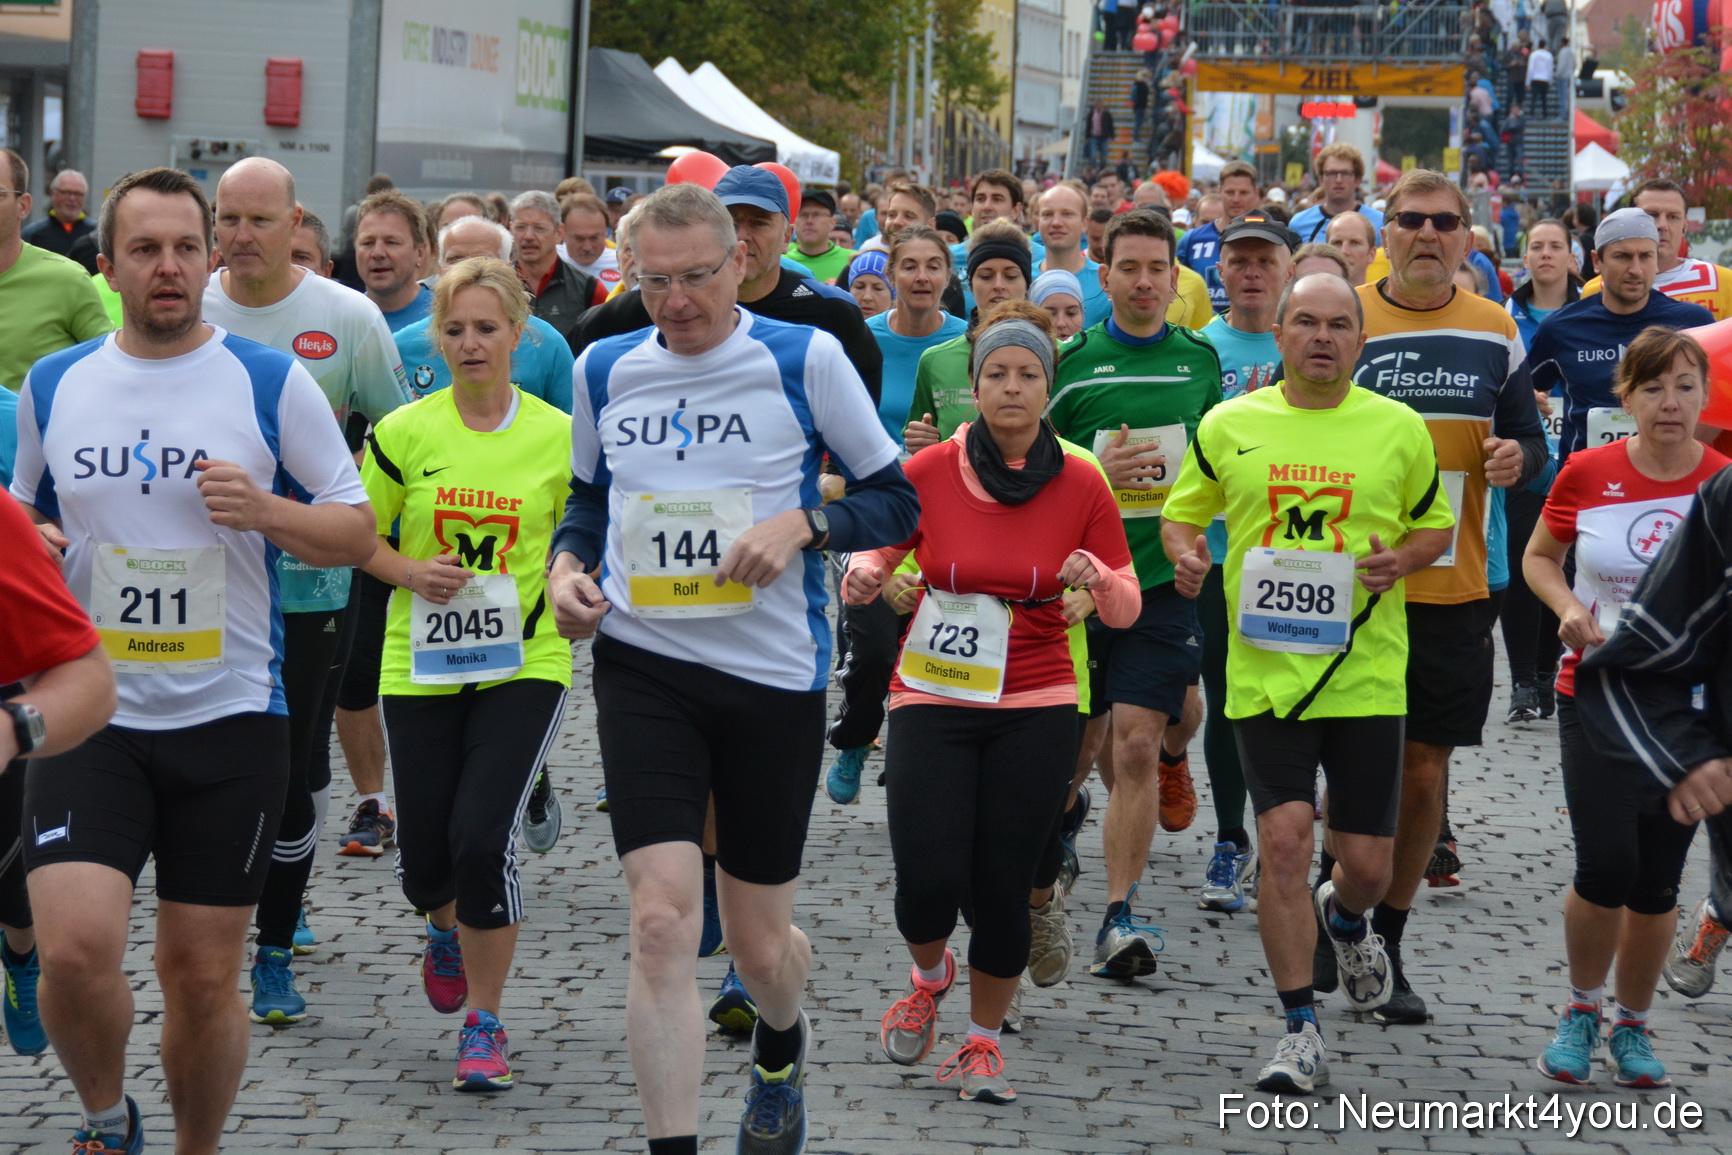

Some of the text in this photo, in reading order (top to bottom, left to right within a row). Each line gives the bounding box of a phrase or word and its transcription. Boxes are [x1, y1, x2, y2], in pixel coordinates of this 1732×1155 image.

[516, 20, 569, 110] BOCK
[1301, 69, 1360, 91] ZIEL
[1192, 242, 1215, 259] 11
[298, 337, 333, 353] Hervis
[1577, 348, 1616, 362] EURO
[1093, 365, 1115, 374] JAKO
[1376, 366, 1479, 388] Fischer
[1386, 388, 1474, 398] AUTOMOBILE
[617, 404, 752, 456] SUSPA
[74, 435, 209, 488] SUSPA
[1268, 464, 1356, 485] Müller
[434, 487, 523, 512] Müller
[1120, 491, 1164, 503] Christian
[667, 502, 713, 514] BOCK
[1284, 506, 1329, 541] M
[455, 533, 498, 571] M
[652, 529, 721, 568] 144
[139, 559, 187, 571] BOCK
[1284, 558, 1322, 570] BOCK
[455, 585, 485, 596] OCK
[673, 582, 700, 596] Rolf
[1256, 580, 1335, 615] 2598
[120, 586, 187, 625] 211
[943, 601, 978, 612] BOCK
[426, 607, 504, 644] 2045
[1267, 621, 1319, 638] Wolfgang
[127, 638, 185, 653] Andreas
[928, 621, 980, 658] 123
[446, 652, 487, 666] Monika
[925, 661, 970, 681] Christina
